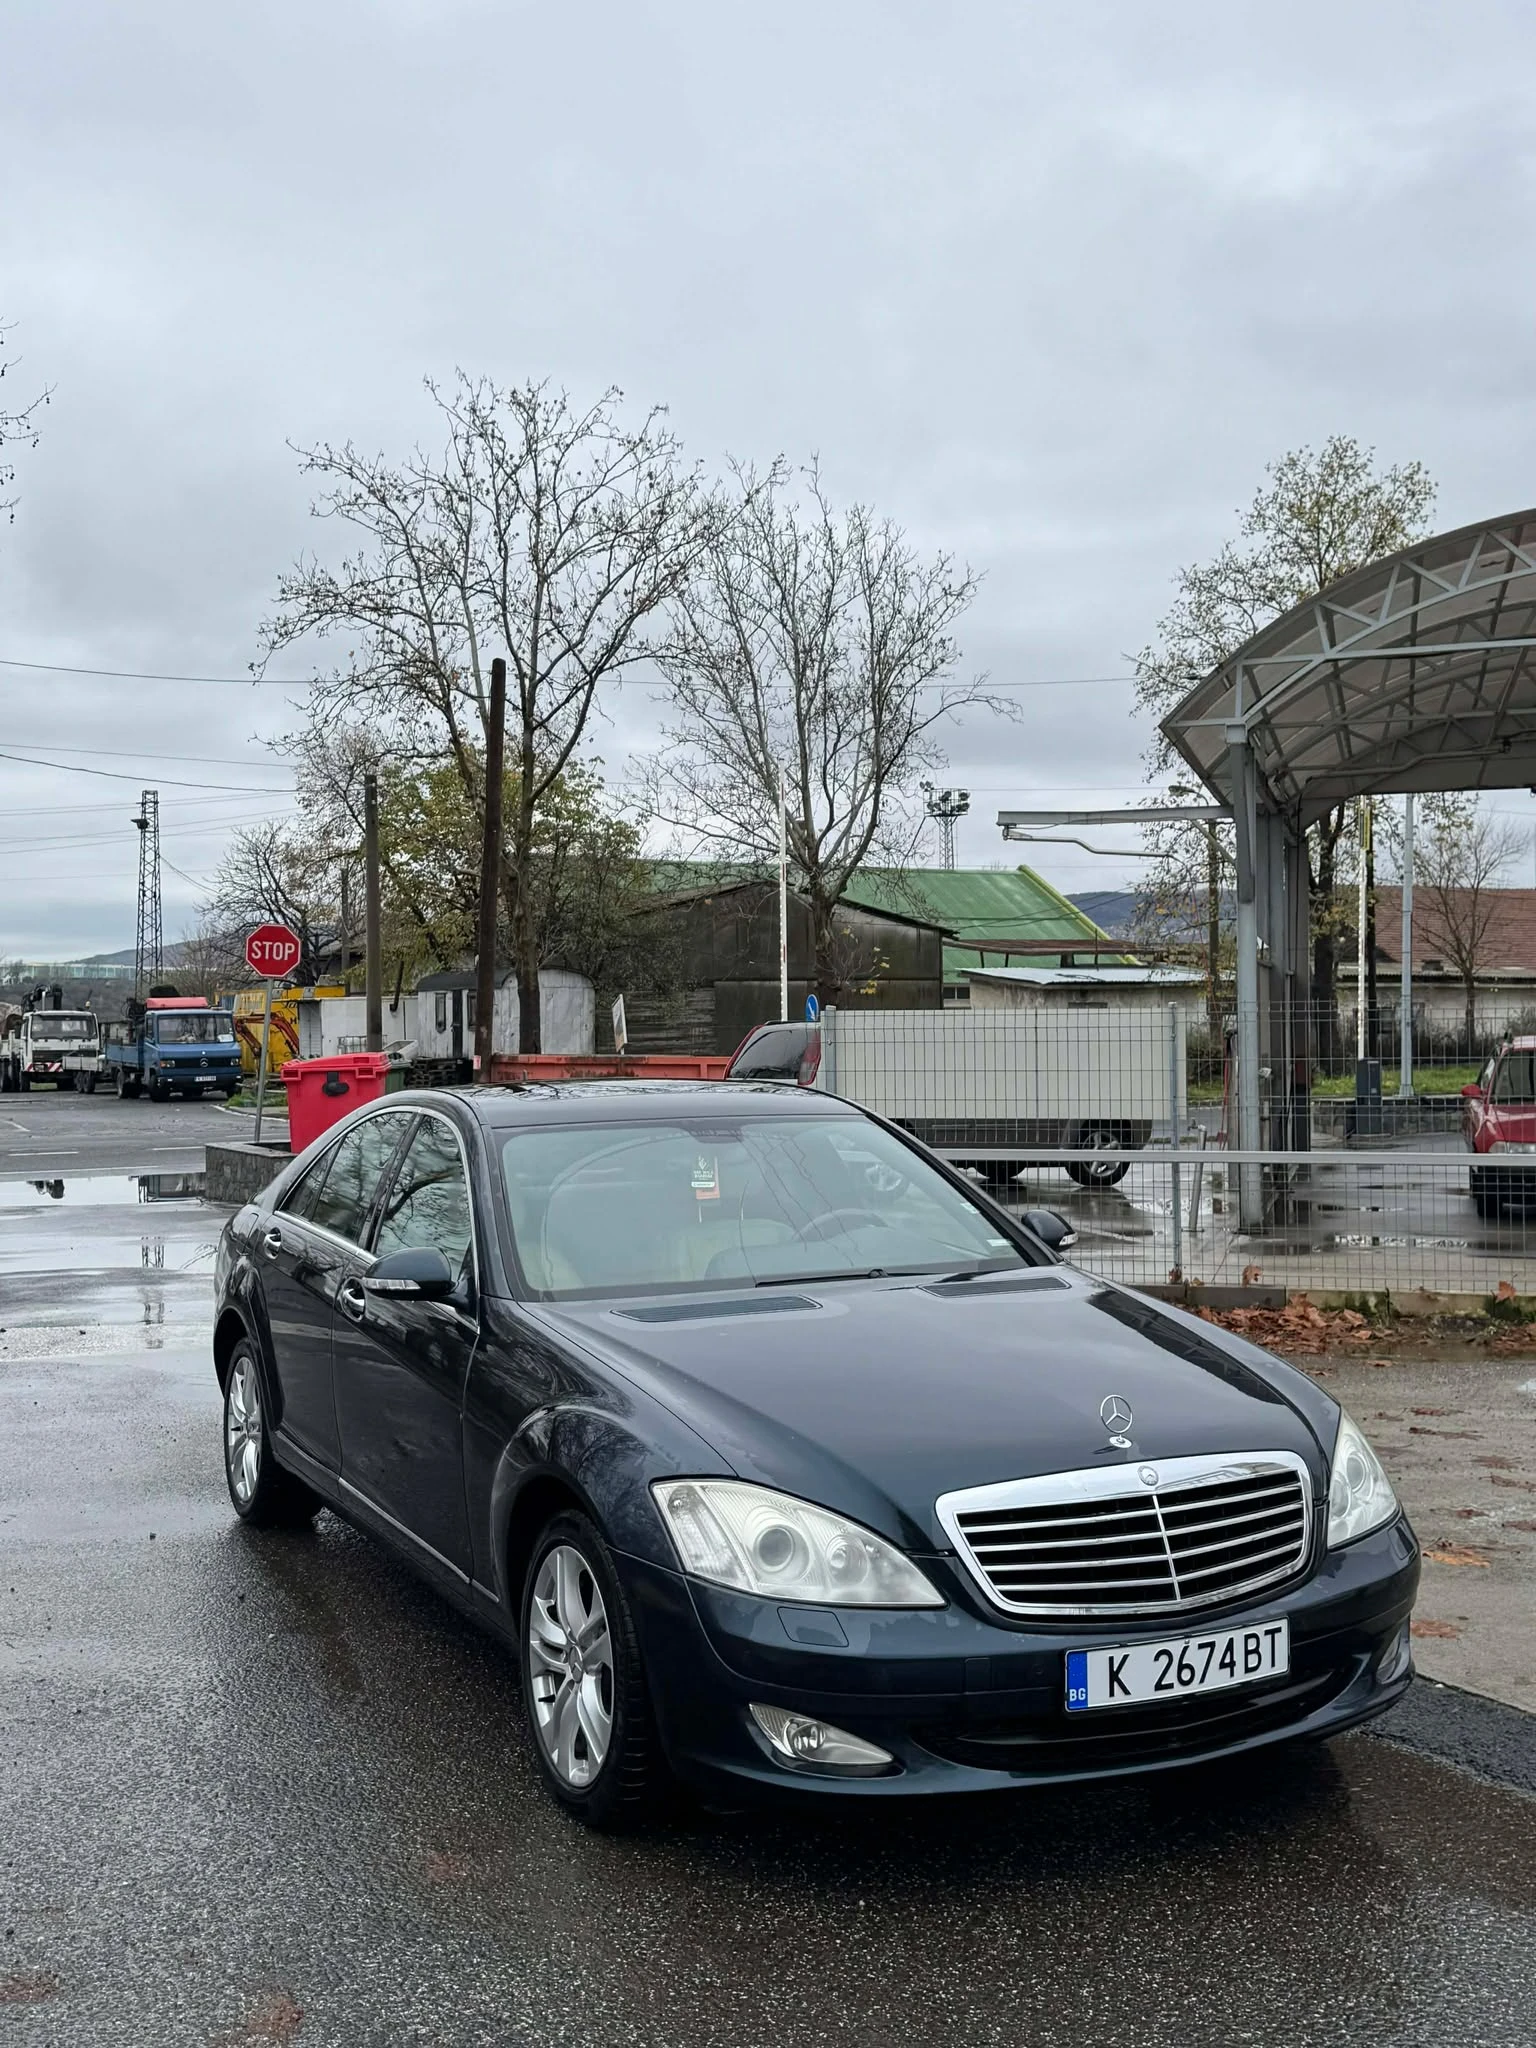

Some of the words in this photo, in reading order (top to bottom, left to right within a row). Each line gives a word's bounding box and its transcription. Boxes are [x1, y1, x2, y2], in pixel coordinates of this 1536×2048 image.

[251, 940, 295, 961] STOP
[1108, 1653, 1131, 1697] K
[1069, 1688, 1086, 1701] BG
